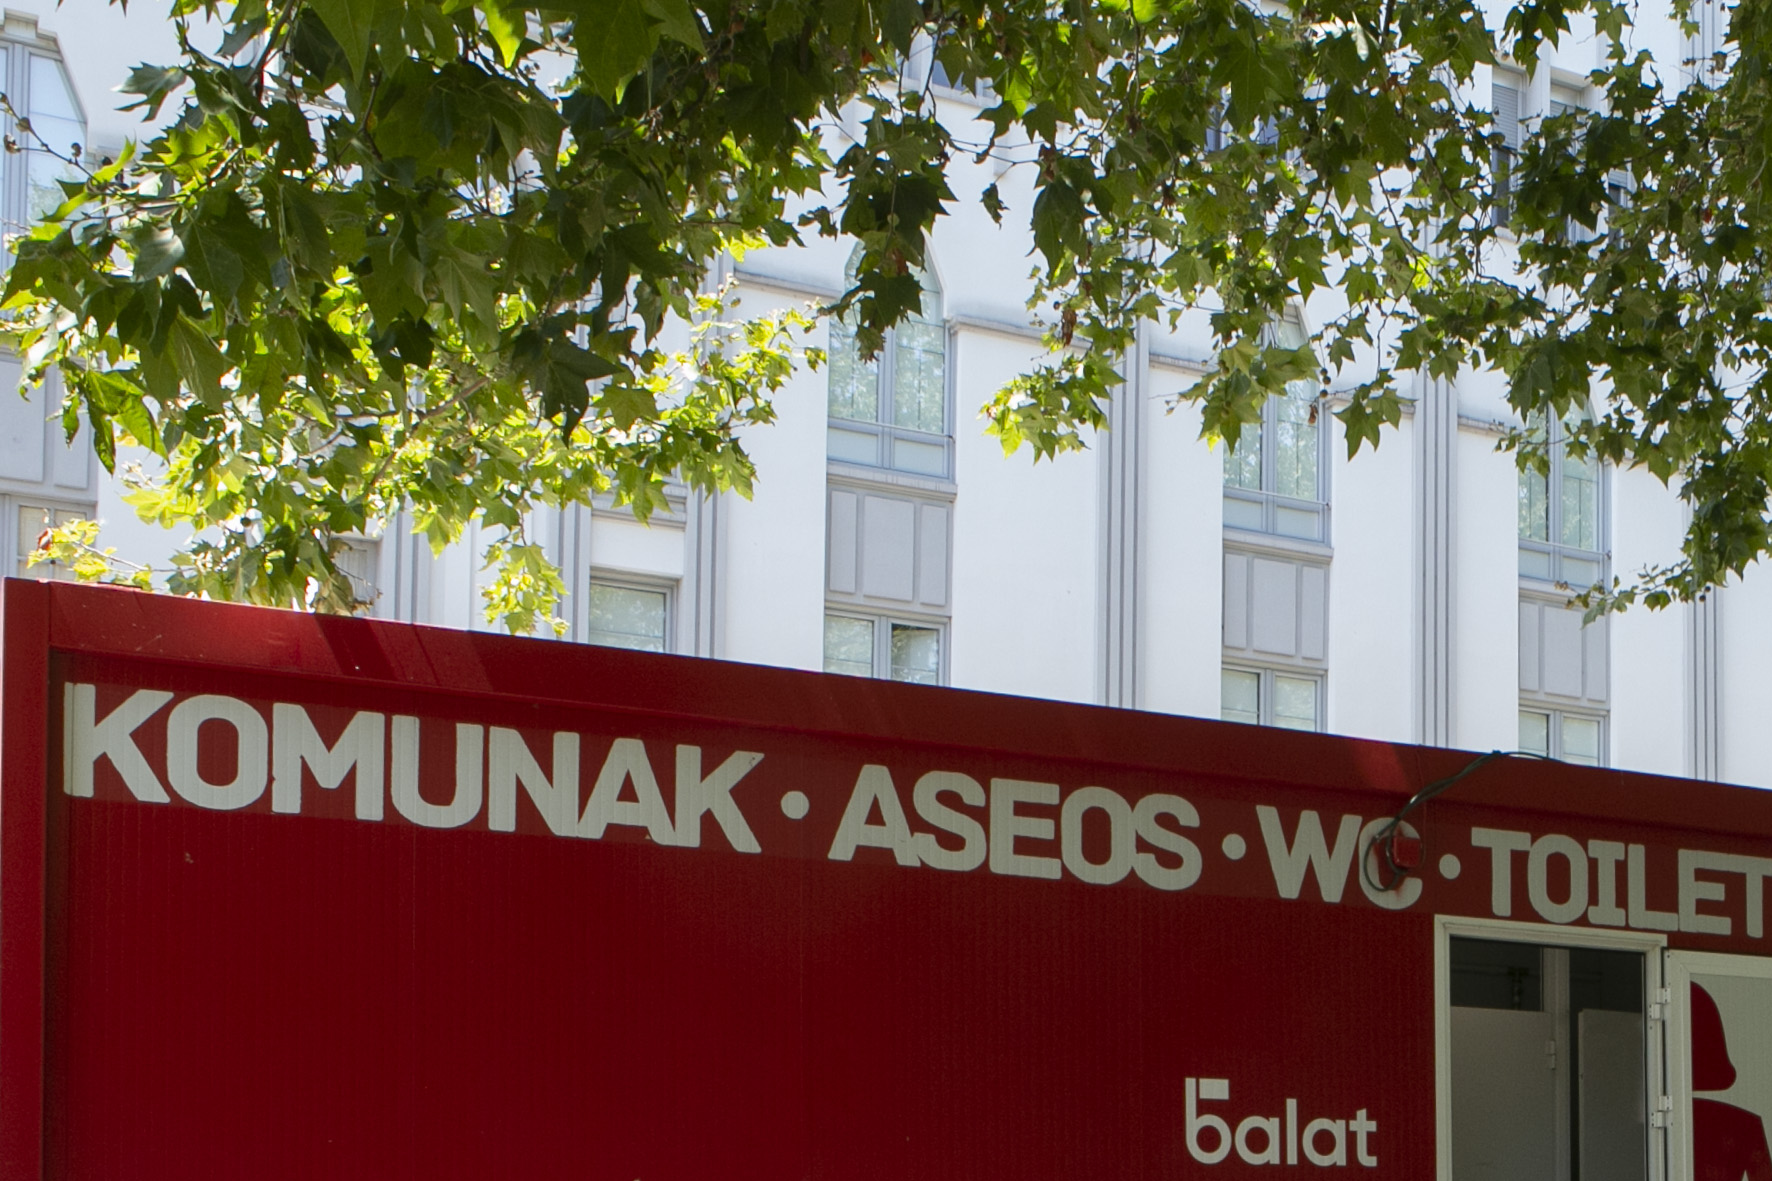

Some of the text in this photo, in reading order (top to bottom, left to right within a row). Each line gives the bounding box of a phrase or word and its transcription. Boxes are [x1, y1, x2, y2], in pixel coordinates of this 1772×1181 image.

[63, 681, 765, 854] KOMUNAK
[828, 764, 1203, 891] ASEOS
[1256, 804, 1424, 911] WC
[1185, 1077, 1378, 1168] balat
